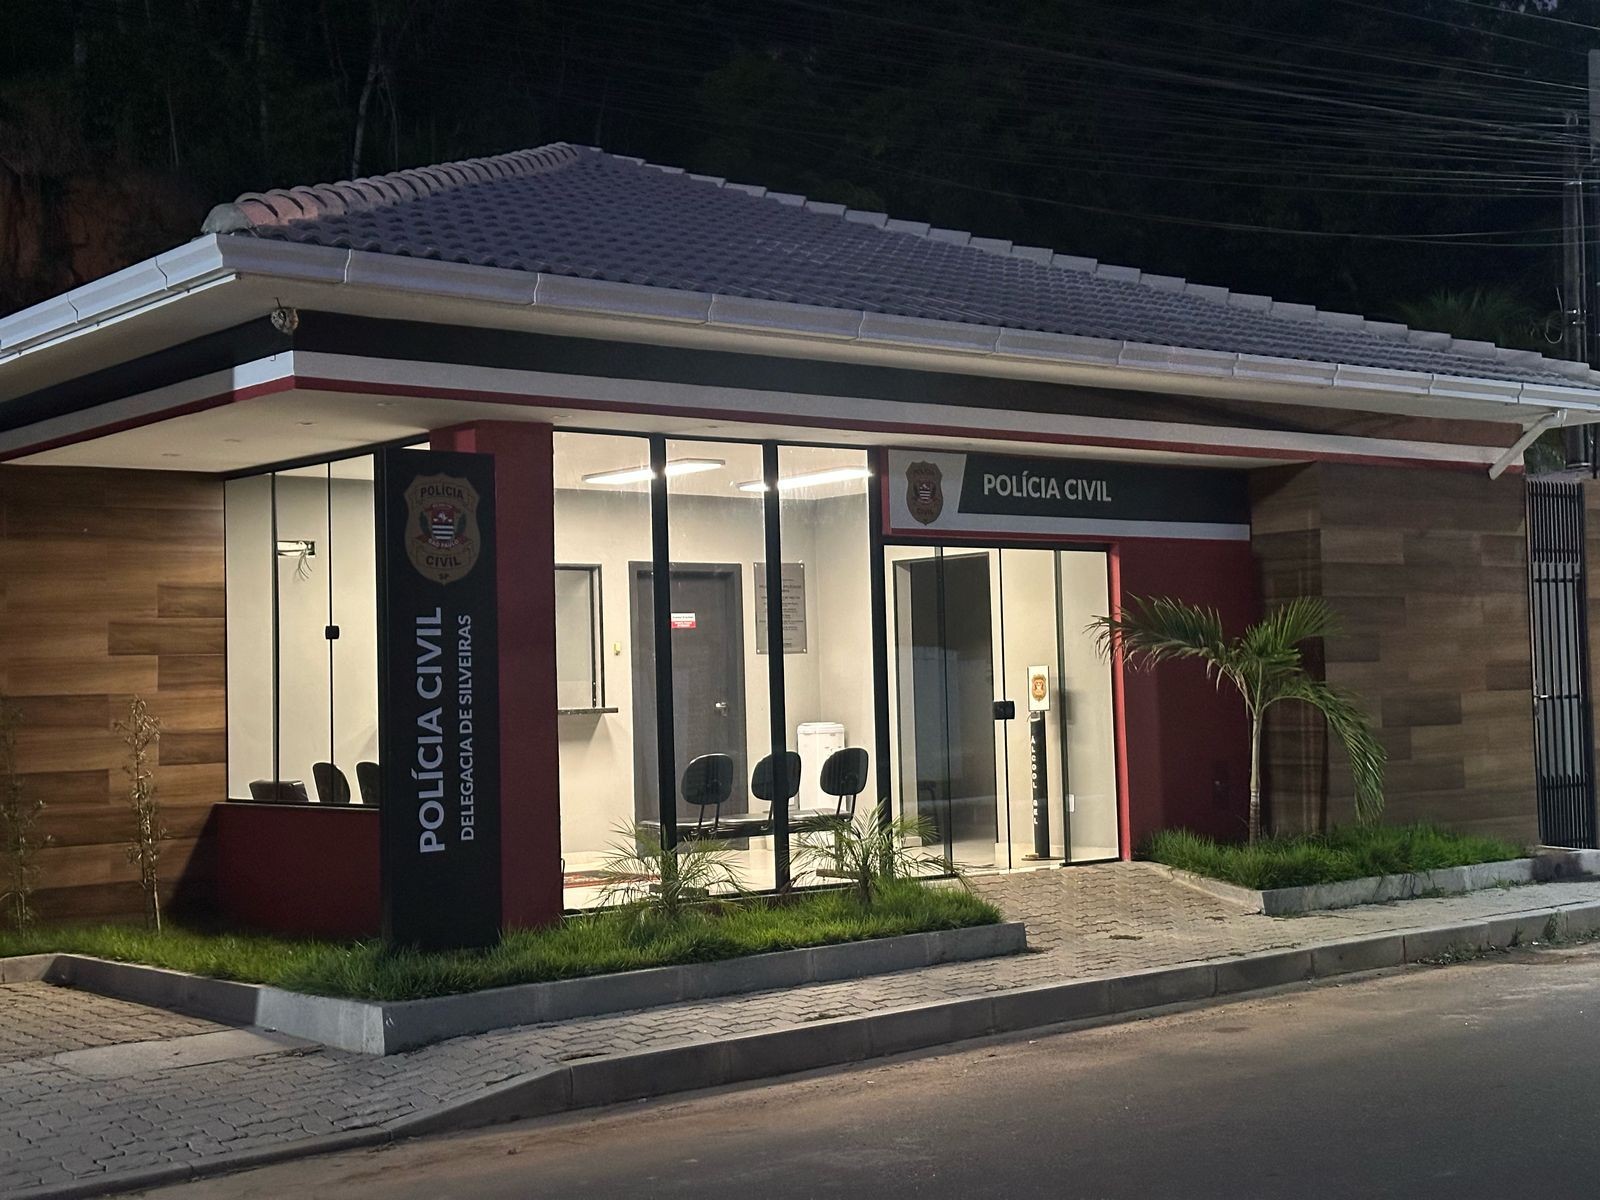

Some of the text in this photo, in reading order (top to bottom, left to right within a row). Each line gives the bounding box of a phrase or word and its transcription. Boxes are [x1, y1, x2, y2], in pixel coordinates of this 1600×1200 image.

[420, 484, 464, 499] POLÍCIA
[983, 471, 1112, 502] POLÍCIA CIVIL
[426, 555, 461, 567] CIVIL
[411, 607, 445, 853] POLÍCIA CIVIL
[458, 615, 474, 841] DELEGACIA DE SILVEIRAS
